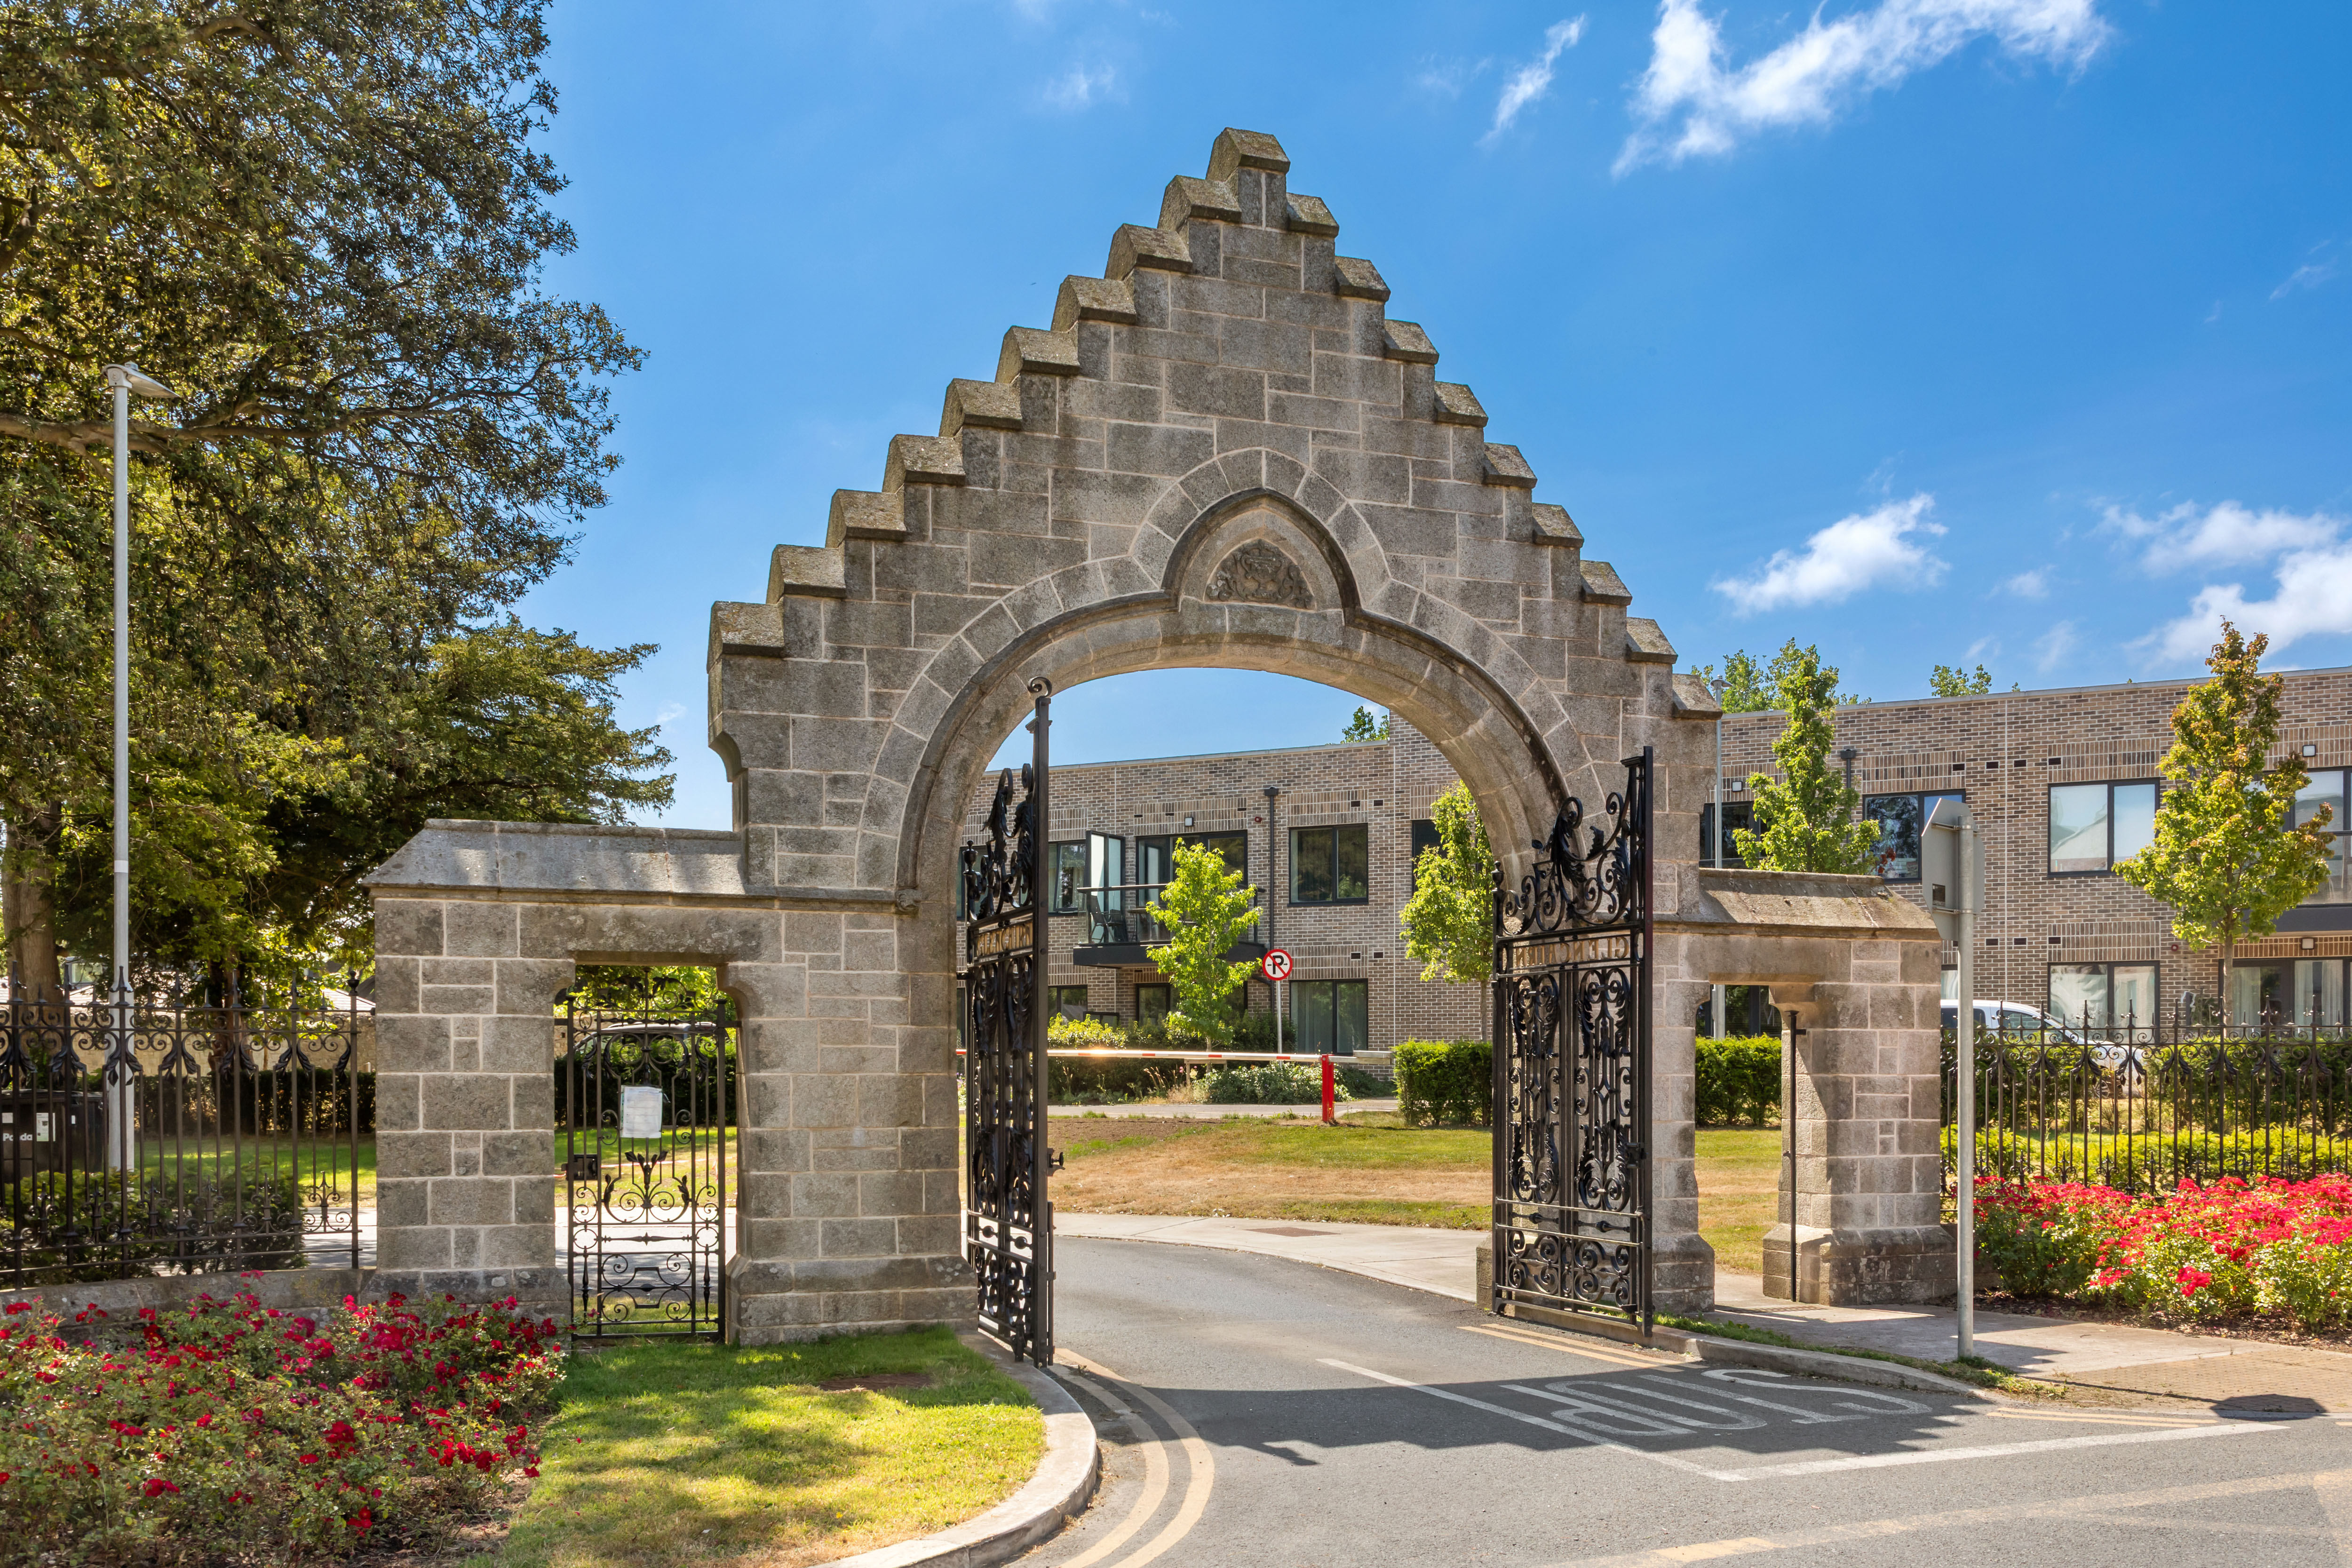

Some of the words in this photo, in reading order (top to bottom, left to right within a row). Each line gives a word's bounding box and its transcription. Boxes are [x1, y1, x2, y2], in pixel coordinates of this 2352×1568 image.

[1272, 955, 1284, 974] P
[3, 1133, 33, 1141] Pada
[1498, 1369, 1933, 1436] STOP
